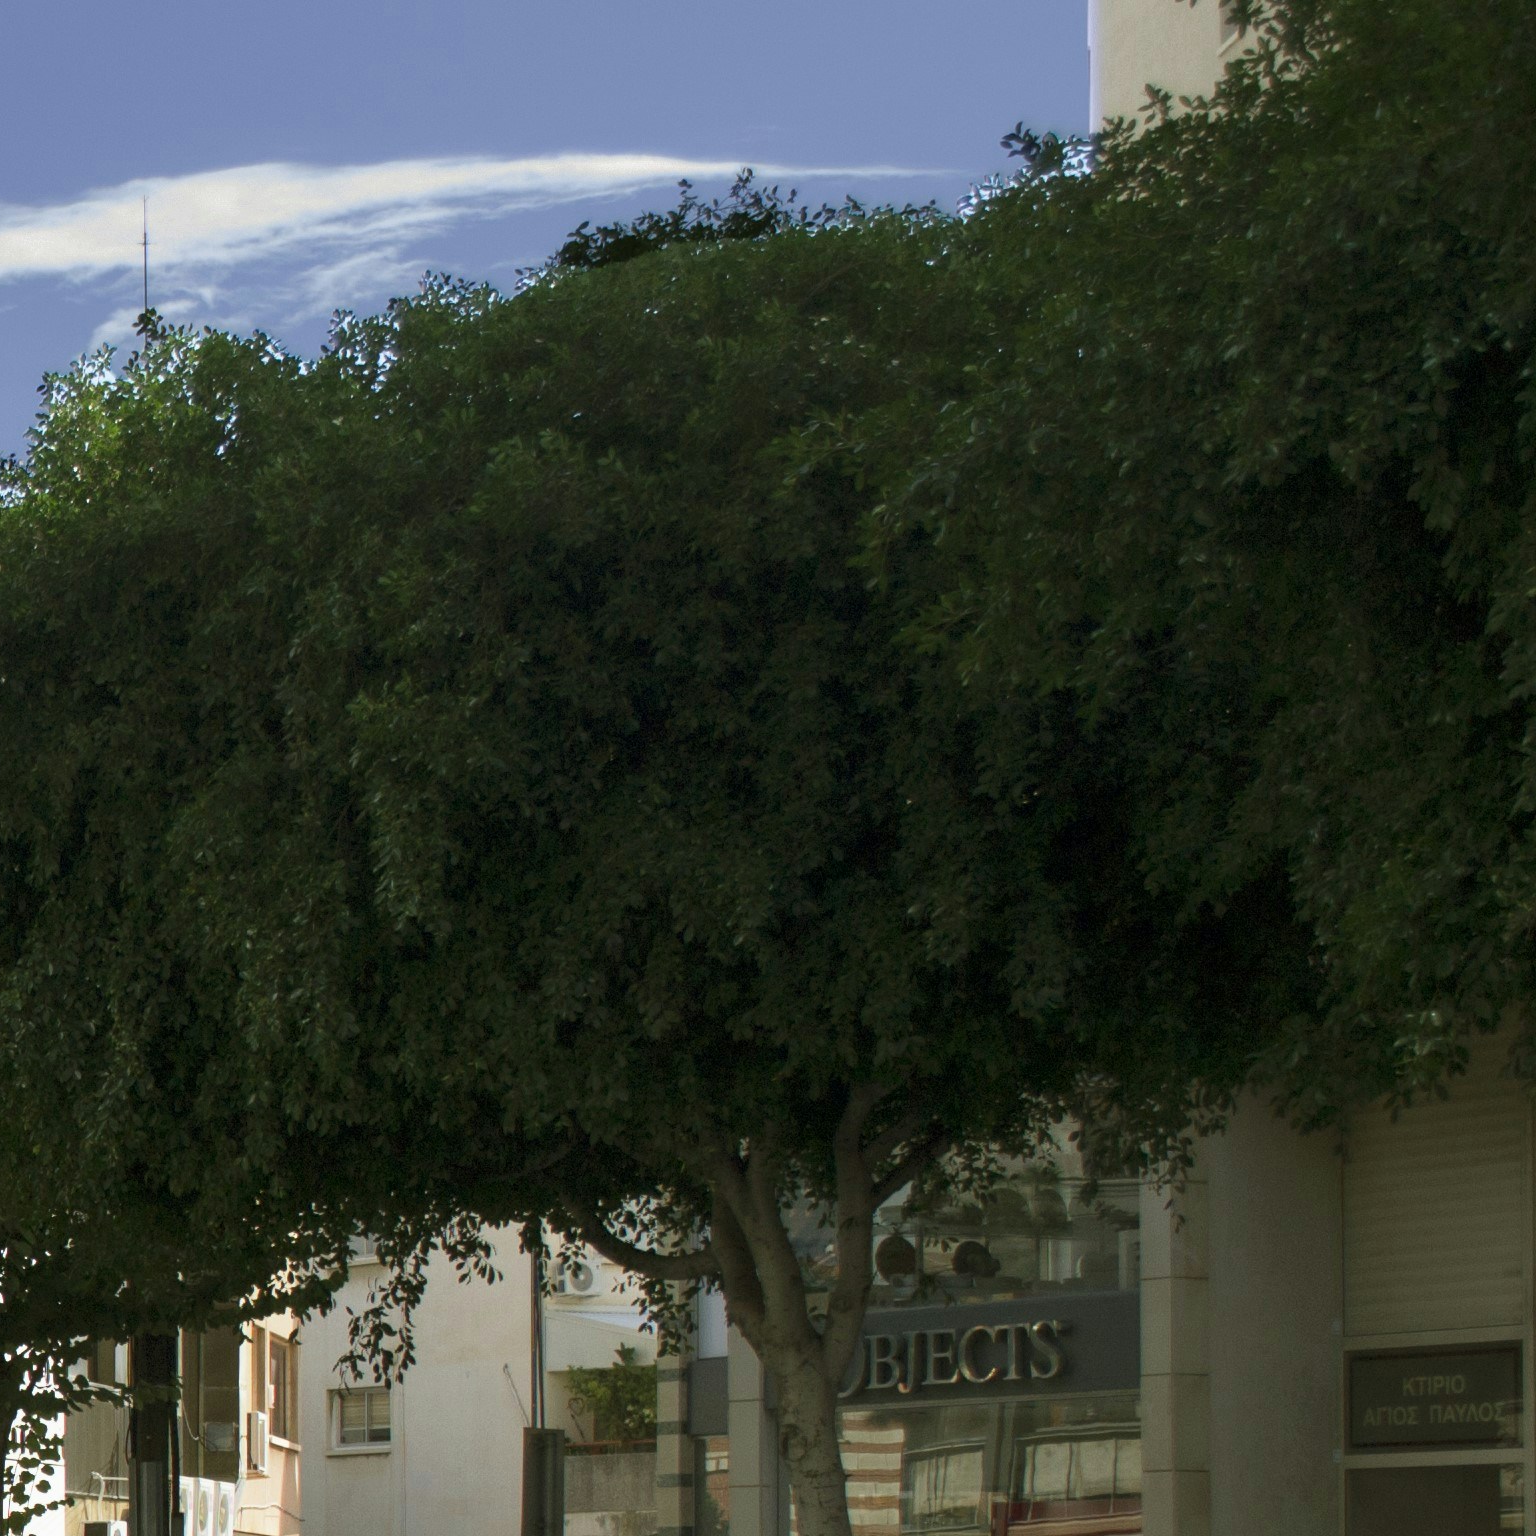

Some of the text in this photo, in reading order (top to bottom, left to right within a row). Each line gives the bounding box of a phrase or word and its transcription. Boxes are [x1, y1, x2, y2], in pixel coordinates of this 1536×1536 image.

[1402, 1375, 1466, 1397] ΚΤΙΡΙΟ
[1362, 1401, 1507, 1427] ΑΓΙΟΣ ΠΑΥΛΟΣ
